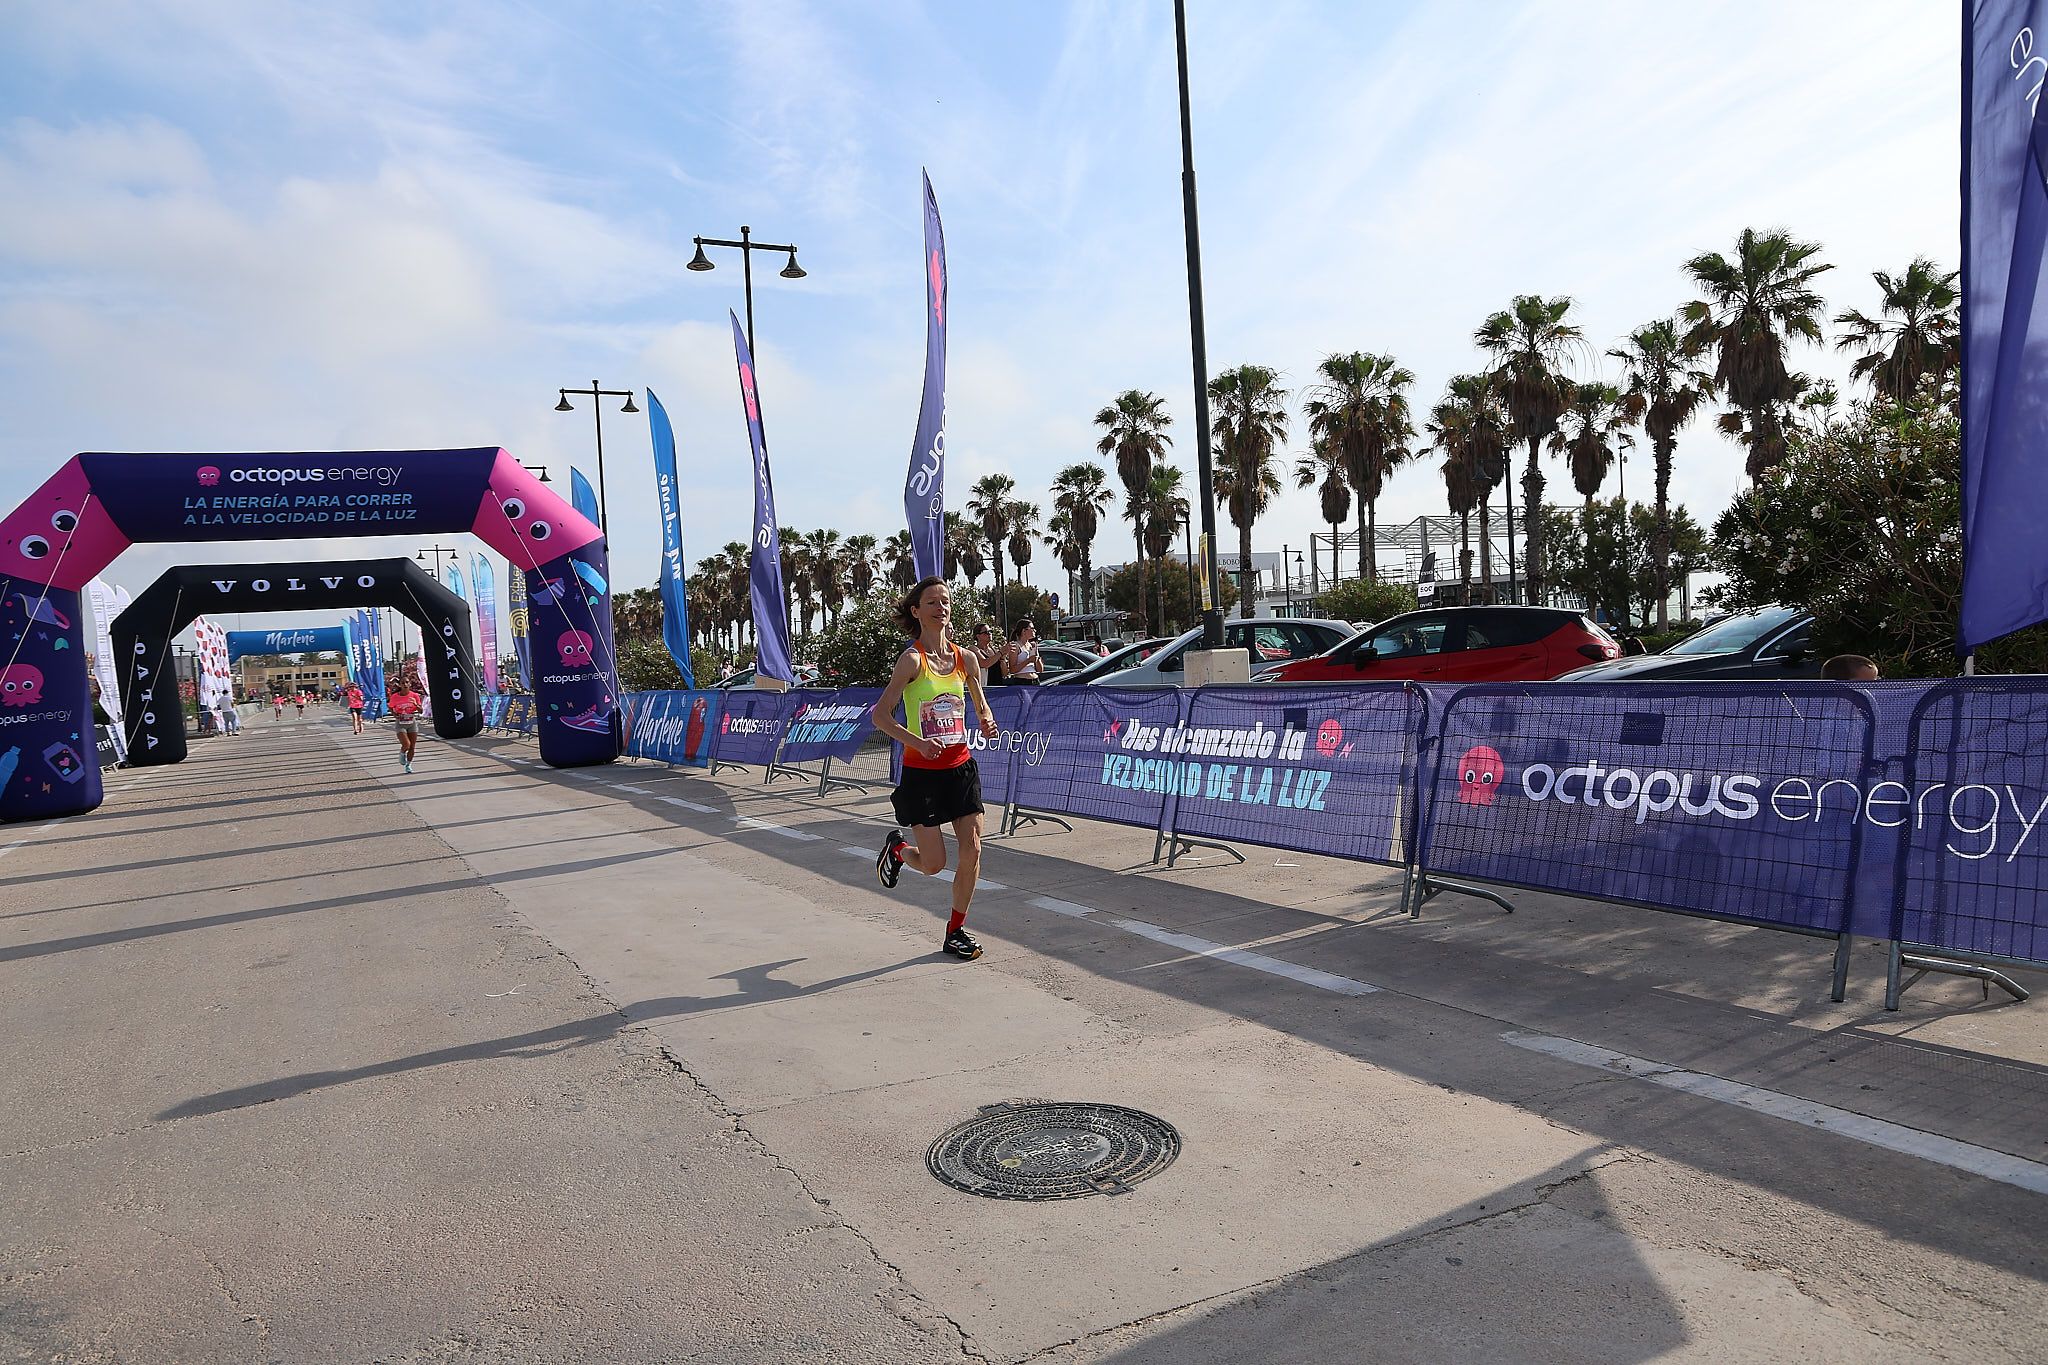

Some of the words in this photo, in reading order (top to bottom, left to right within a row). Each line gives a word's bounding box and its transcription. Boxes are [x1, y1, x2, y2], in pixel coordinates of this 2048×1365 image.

[230, 466, 325, 487] octopus
[327, 464, 402, 486] energy
[184, 497, 208, 510] LA
[212, 493, 290, 510] ENERGÍA
[294, 494, 342, 508] PARA
[345, 493, 412, 507] CORRER
[184, 513, 197, 526] A
[202, 512, 224, 525] LA
[228, 510, 330, 525] VELOCIDAD
[333, 510, 354, 523] DE
[360, 510, 382, 522] LA
[385, 508, 418, 521] LUZ
[211, 575, 376, 593] VOLVO
[265, 630, 316, 651] Marlene
[443, 624, 464, 723] VOLVO
[543, 674, 580, 684] octopus
[134, 642, 159, 750] VOLVO
[29, 710, 72, 722] energy
[730, 716, 758, 738] octopus
[1121, 718, 1158, 752] Has
[1160, 720, 1276, 760] alcanzado
[1278, 722, 1307, 760] la
[1101, 752, 1203, 798] VELOCIDAD
[1204, 764, 1238, 802] DE
[1239, 766, 1274, 806] LA
[1276, 768, 1332, 812] LUZ
[1522, 760, 1761, 824] octopus
[1770, 778, 2048, 862] energy
